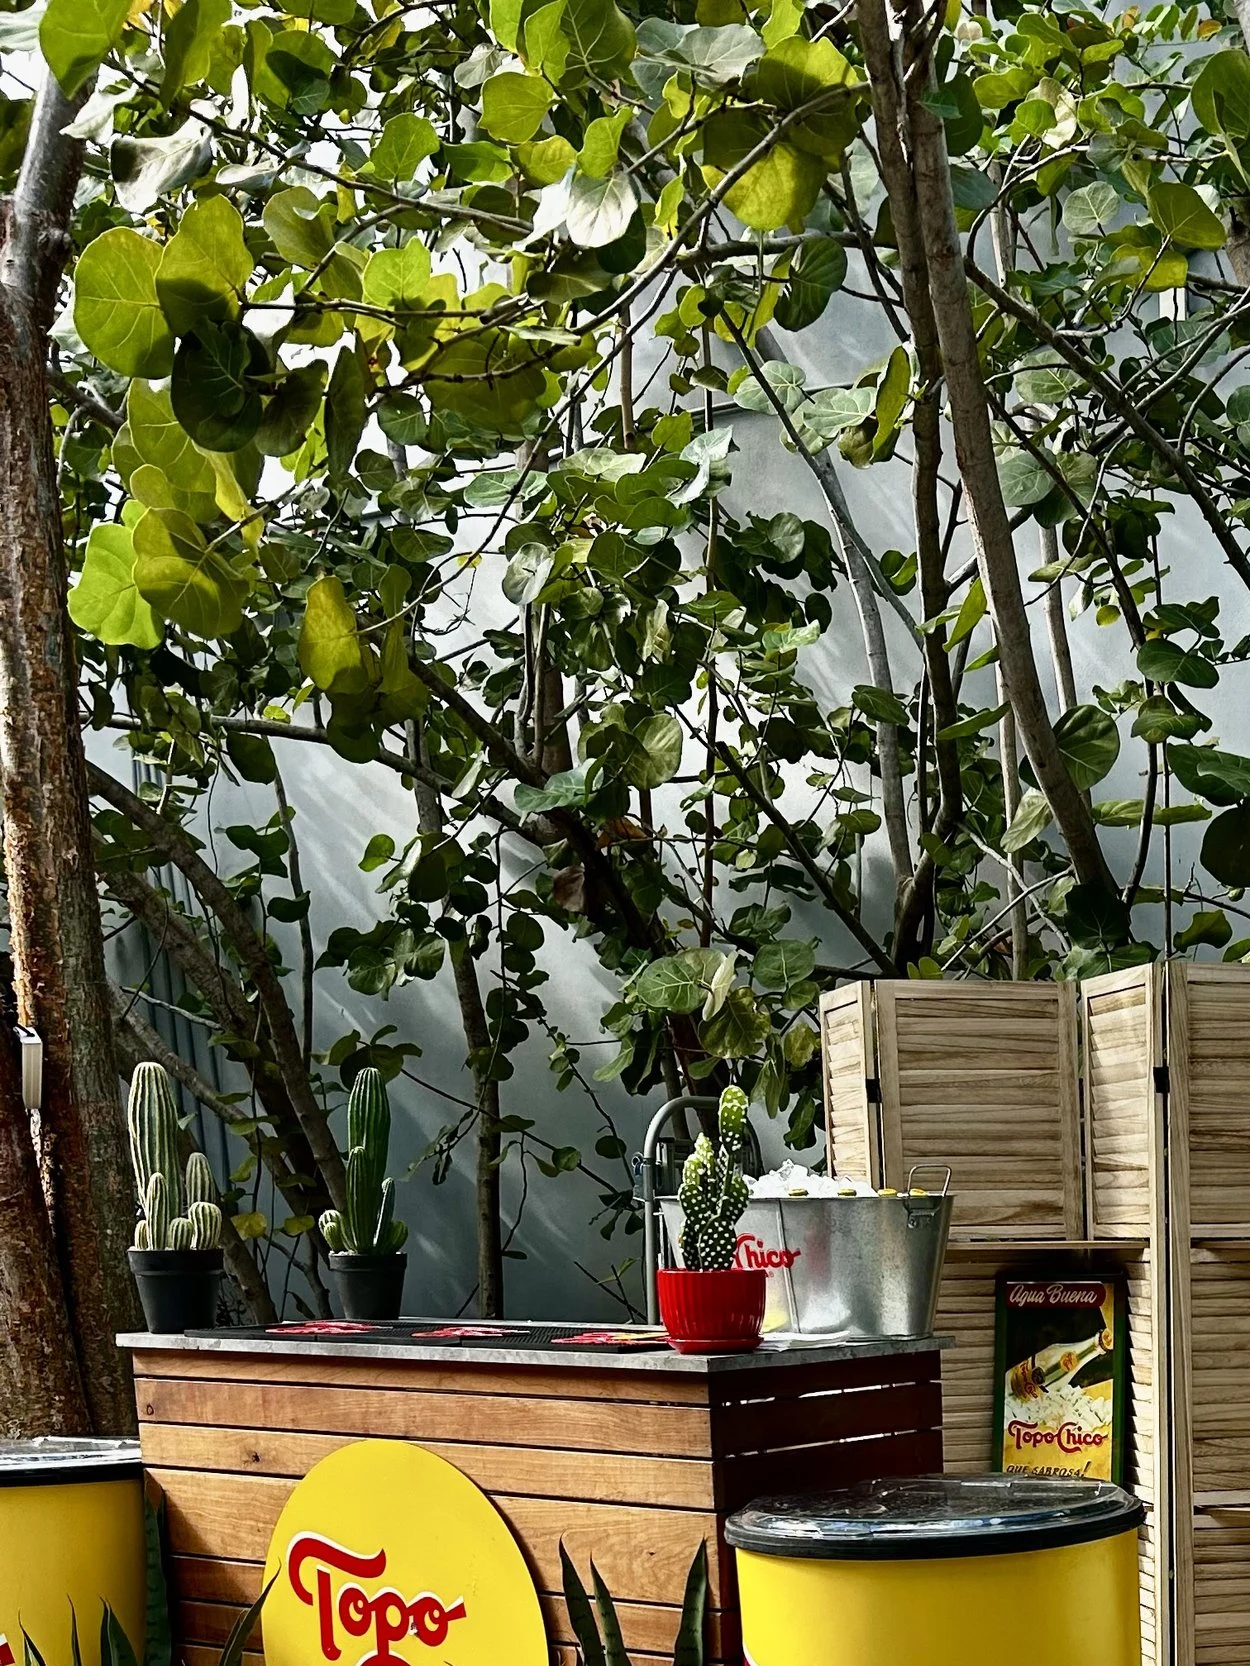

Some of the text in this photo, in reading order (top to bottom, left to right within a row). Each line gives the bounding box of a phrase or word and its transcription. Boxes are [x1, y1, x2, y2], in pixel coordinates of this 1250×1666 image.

[1009, 1283, 1097, 1307] Agua Buena
[1006, 1465, 1029, 1474] QUE
[287, 1531, 467, 1661] Topo
